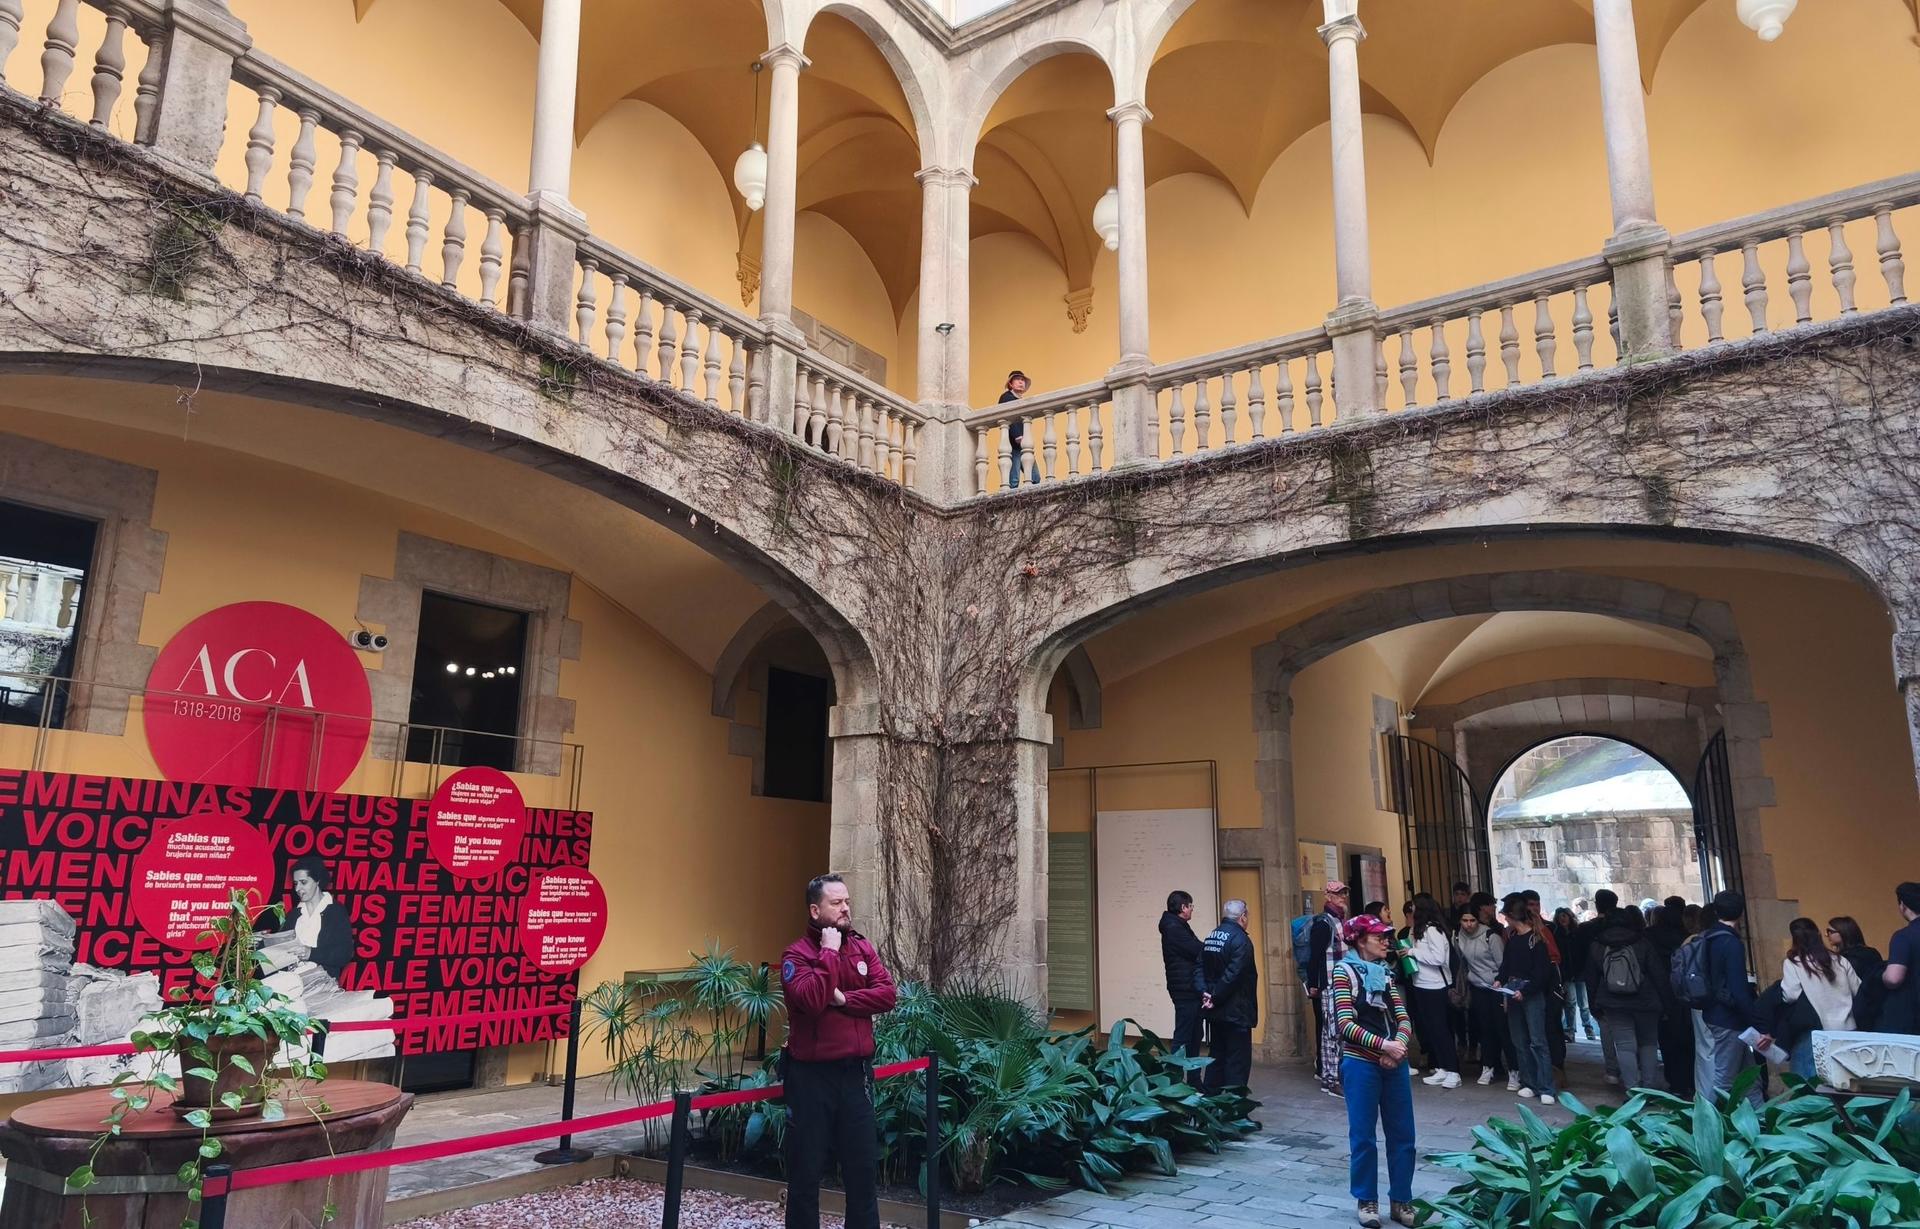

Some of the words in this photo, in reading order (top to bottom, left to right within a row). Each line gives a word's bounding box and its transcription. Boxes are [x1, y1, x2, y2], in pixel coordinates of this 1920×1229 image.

[174, 643, 316, 708] ACA
[173, 700, 241, 722] 1318-2018
[297, 790, 399, 826] VEUS
[463, 814, 476, 822] que
[211, 836, 230, 846] que
[455, 836, 467, 844] Did
[468, 837, 481, 846] you
[482, 836, 502, 845] know
[195, 844, 225, 852] acusadas
[454, 846, 468, 854] that
[184, 872, 203, 882] que
[205, 874, 226, 882] moltes
[171, 900, 188, 910] Did
[191, 902, 208, 912] you
[170, 912, 190, 922] that
[552, 910, 564, 918] que
[176, 922, 210, 930] witchcraft
[166, 930, 186, 938] girls?
[543, 936, 554, 944] Did
[555, 936, 567, 945] you
